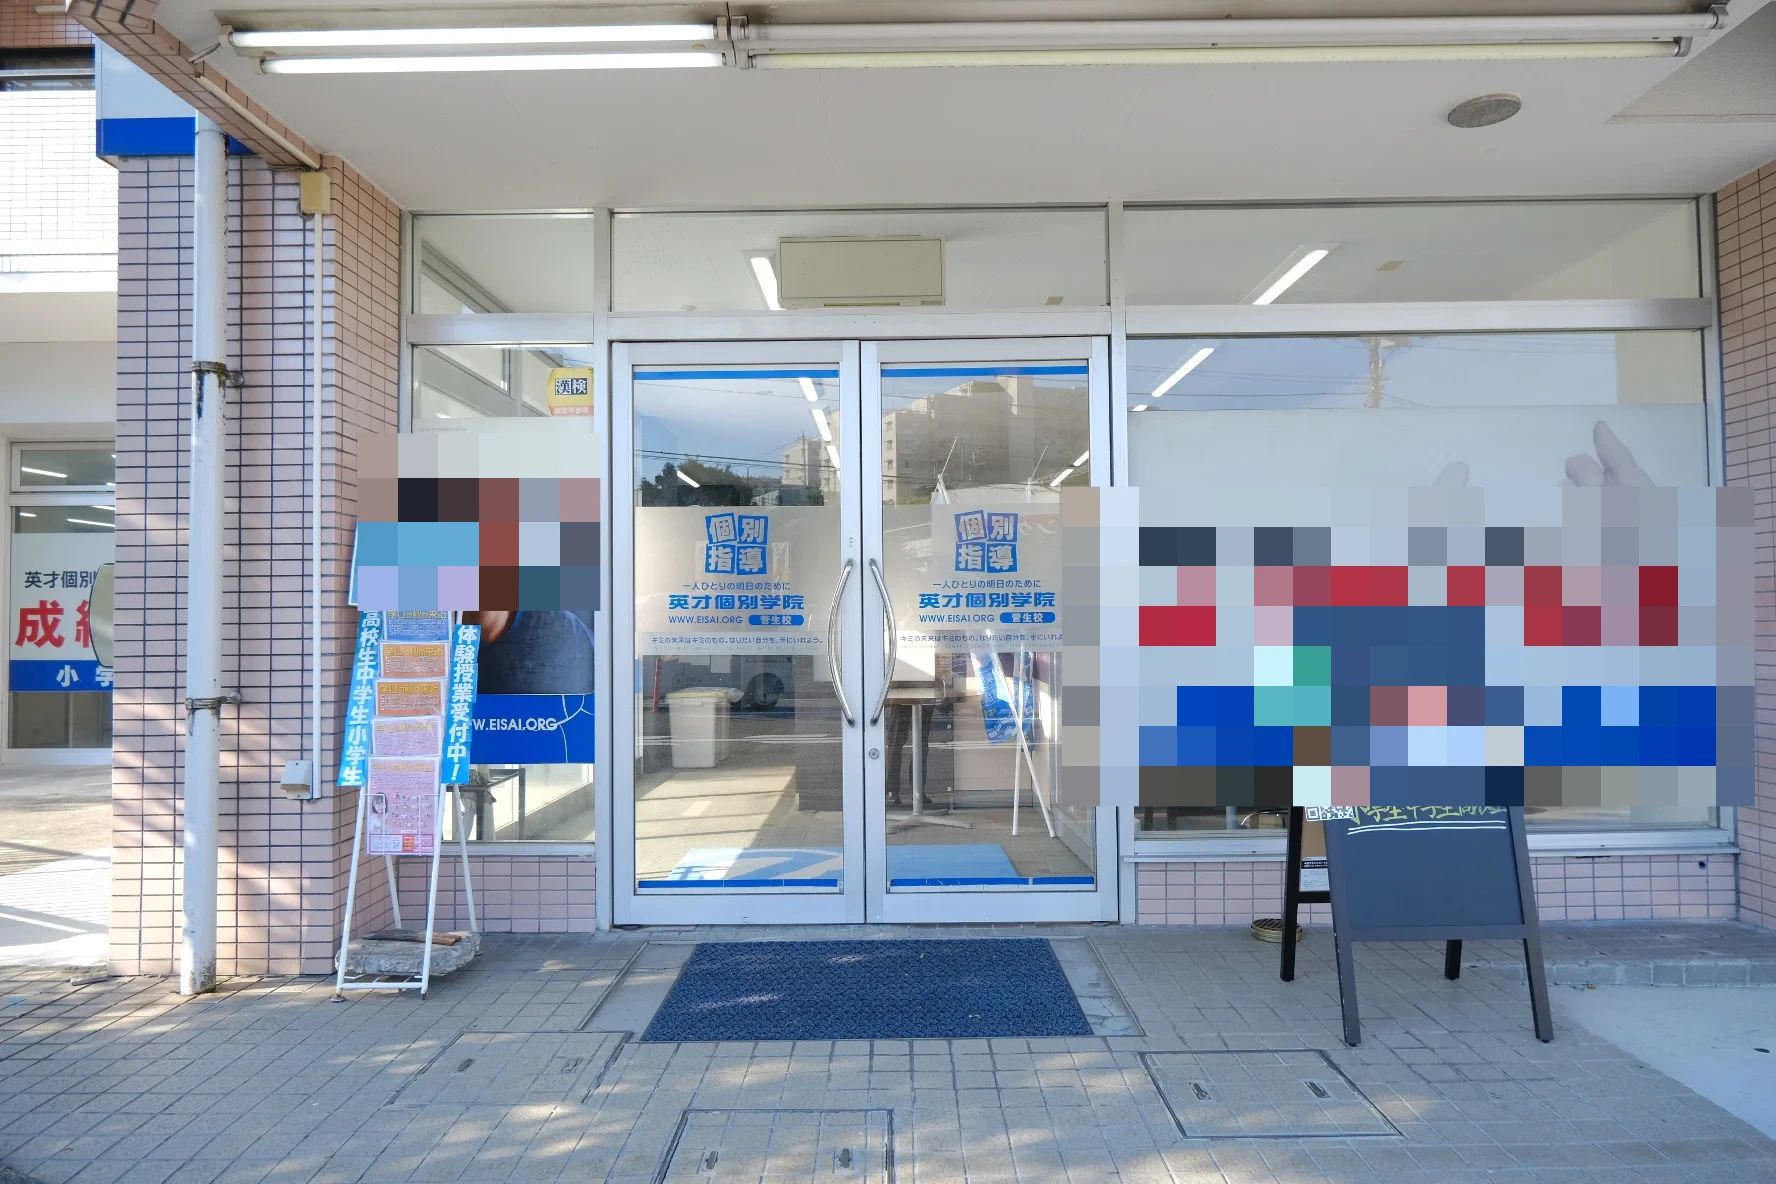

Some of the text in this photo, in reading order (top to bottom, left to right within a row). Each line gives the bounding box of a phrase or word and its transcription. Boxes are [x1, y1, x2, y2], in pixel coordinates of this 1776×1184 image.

[556, 378, 588, 395] 漢検
[707, 515, 767, 544] 個別
[957, 513, 1015, 542] 個別
[708, 546, 764, 573] 指導
[957, 545, 1014, 571] 指導
[682, 581, 791, 591] 一人ひとりの明日のために
[932, 579, 1041, 589] 一人ひとりの明日のために
[668, 594, 804, 610] 英才個別学院
[918, 592, 1055, 609] 英才個別学院
[668, 615, 744, 625] WWW.EISAI.ORG
[919, 613, 995, 623] WWW.EISAI.ORG
[447, 625, 478, 781] 体験授業受付中!
